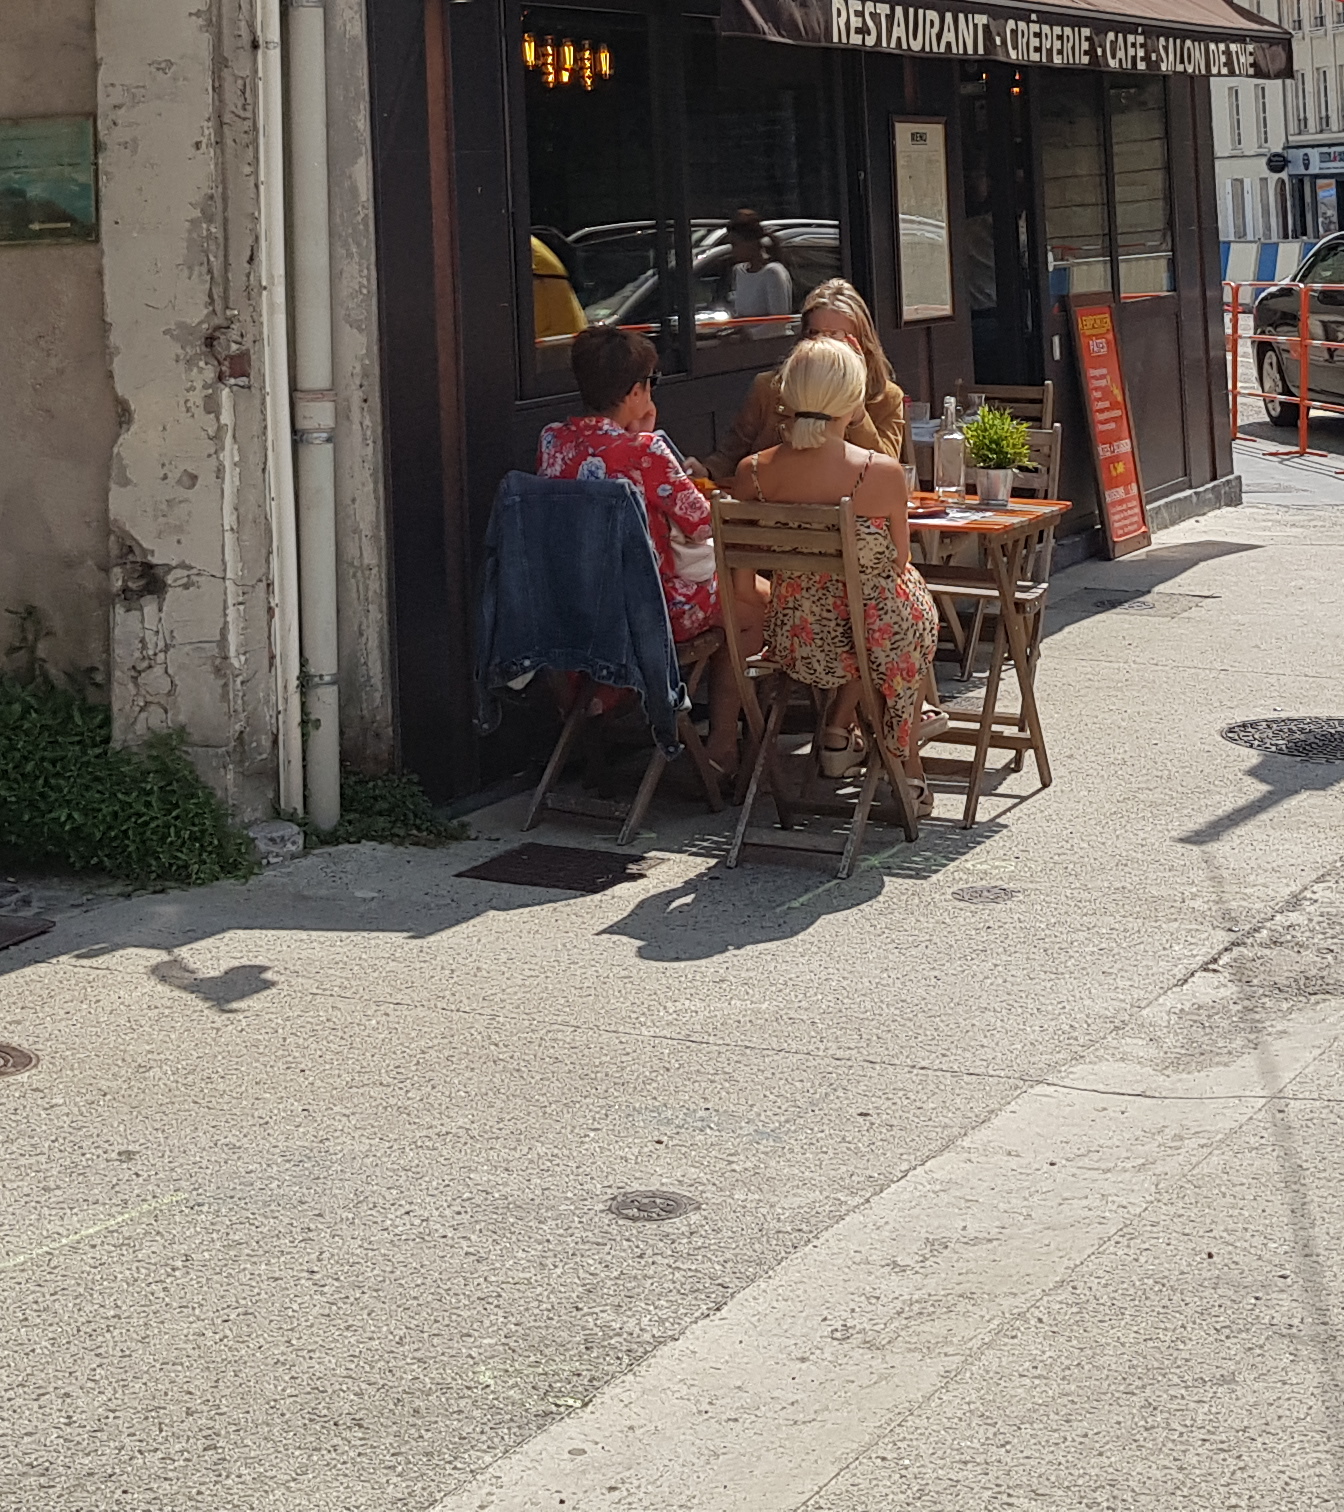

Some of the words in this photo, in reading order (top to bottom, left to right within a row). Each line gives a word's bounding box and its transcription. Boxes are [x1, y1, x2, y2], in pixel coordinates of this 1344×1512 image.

[1006, 13, 1091, 65] CRÊPERIE
[1106, 26, 1147, 70] CAFÉ
[1158, 36, 1206, 75] SALON
[1209, 42, 1229, 75] DE
